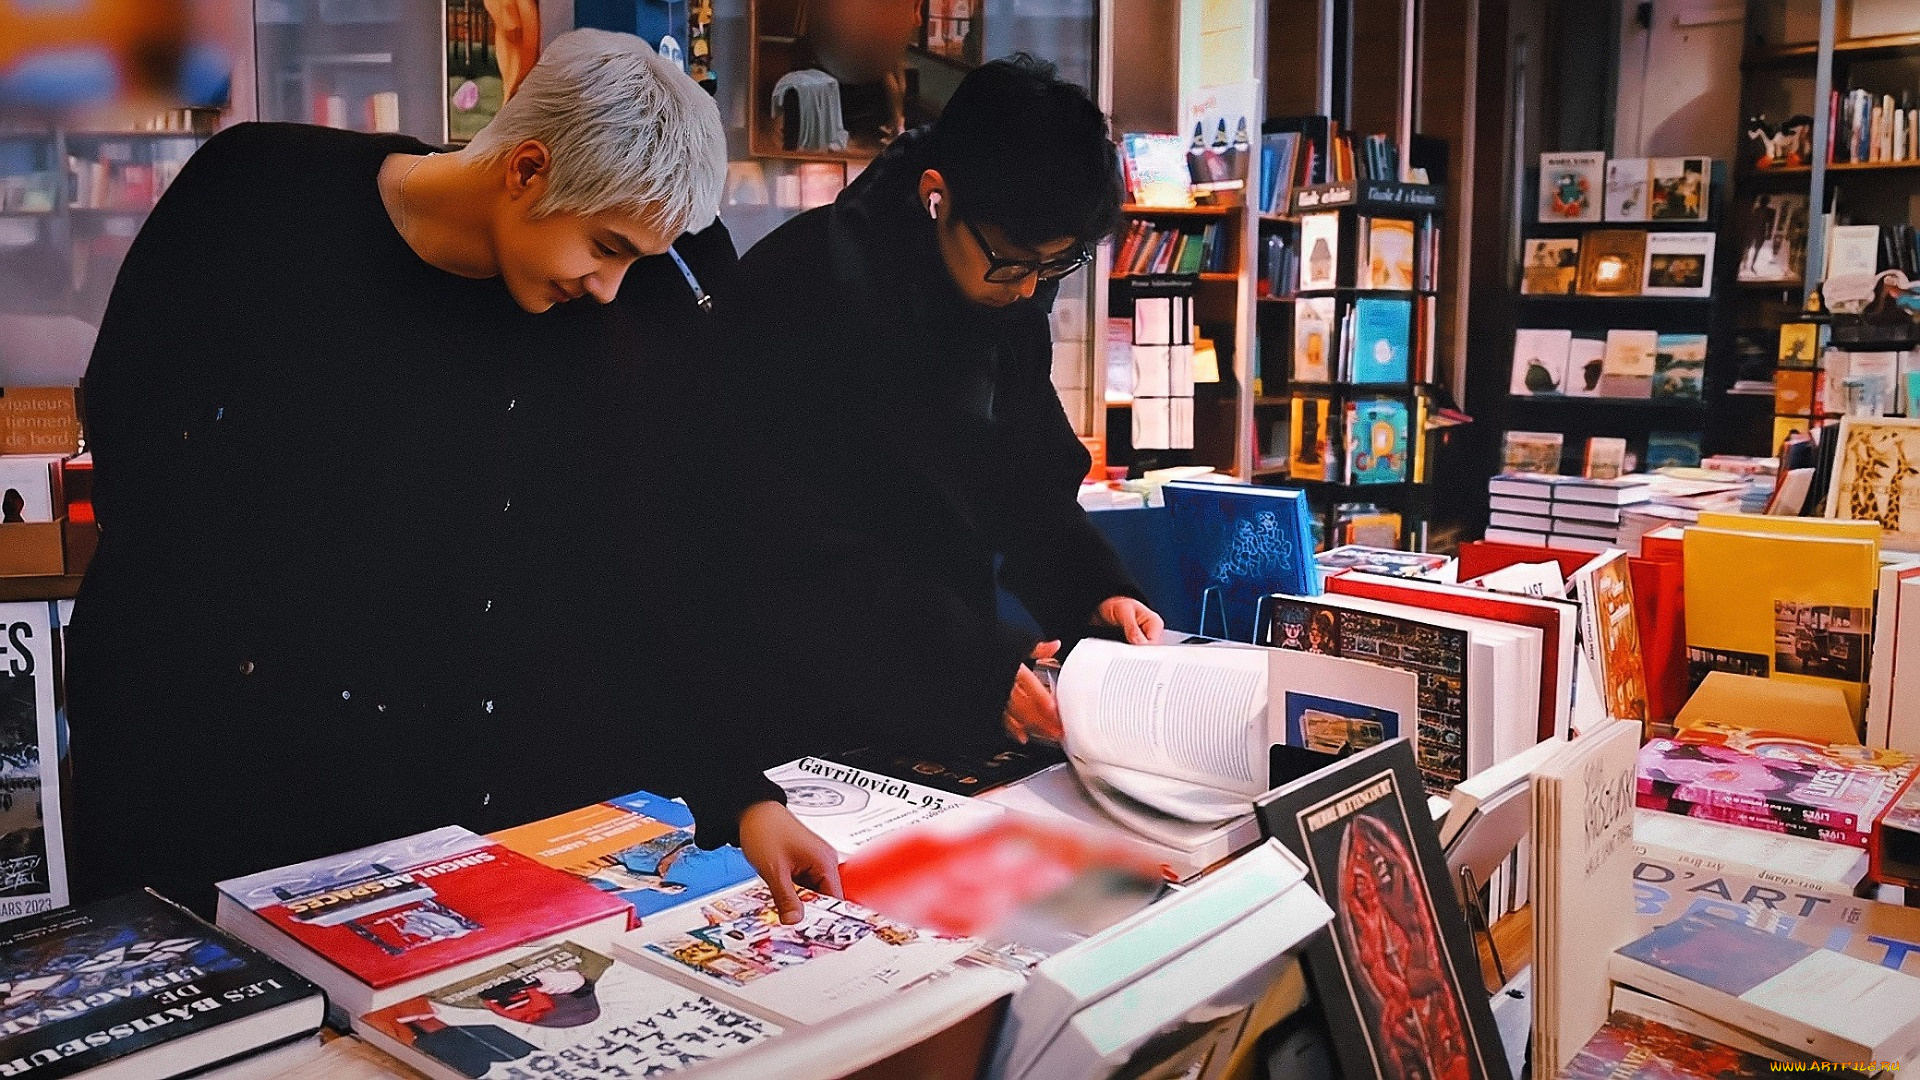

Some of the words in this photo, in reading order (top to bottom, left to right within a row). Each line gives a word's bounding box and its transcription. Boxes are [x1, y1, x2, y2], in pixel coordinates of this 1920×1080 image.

[5, 431, 26, 446] de
[1802, 809, 1830, 822] LIVES
[1818, 828, 1846, 841] LIVES
[153, 983, 202, 1005] DE
[222, 977, 284, 1003] LES
